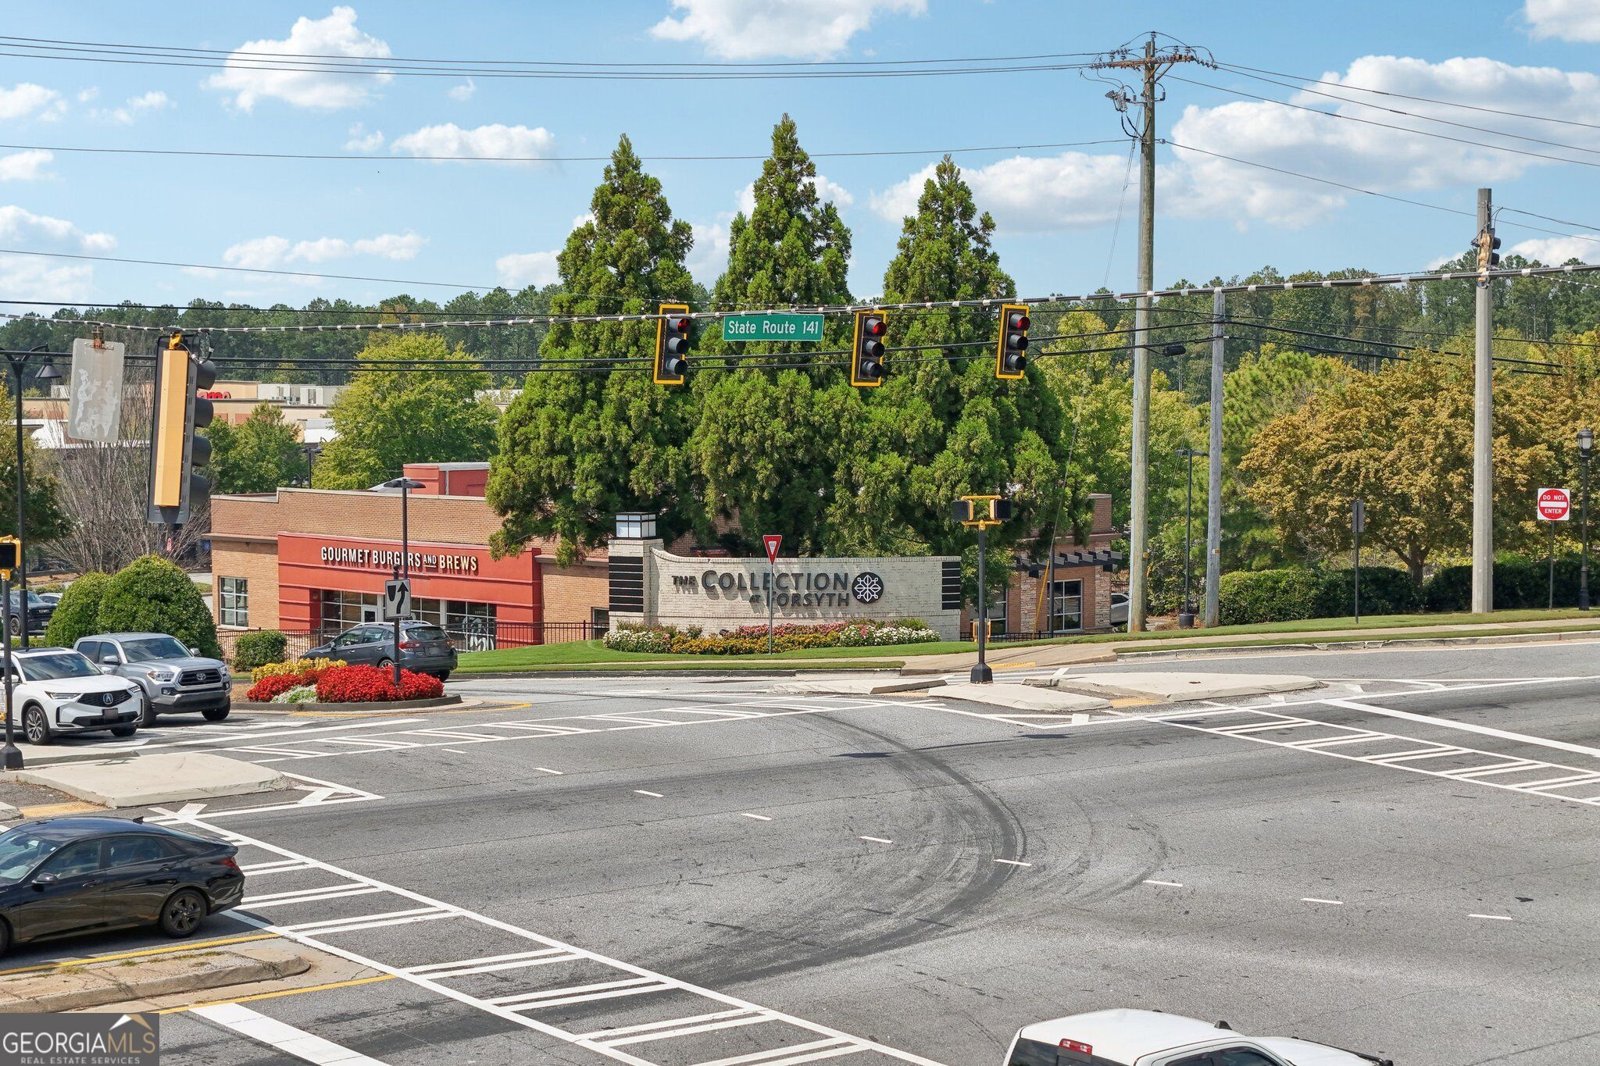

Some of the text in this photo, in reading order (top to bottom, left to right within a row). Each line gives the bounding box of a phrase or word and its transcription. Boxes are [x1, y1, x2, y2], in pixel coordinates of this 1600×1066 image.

[728, 320, 819, 334] State Route 141
[320, 546, 370, 563] GOURMET
[423, 554, 437, 565] AND
[439, 554, 478, 571] BREWS
[671, 569, 849, 591] THE COLLECTION
